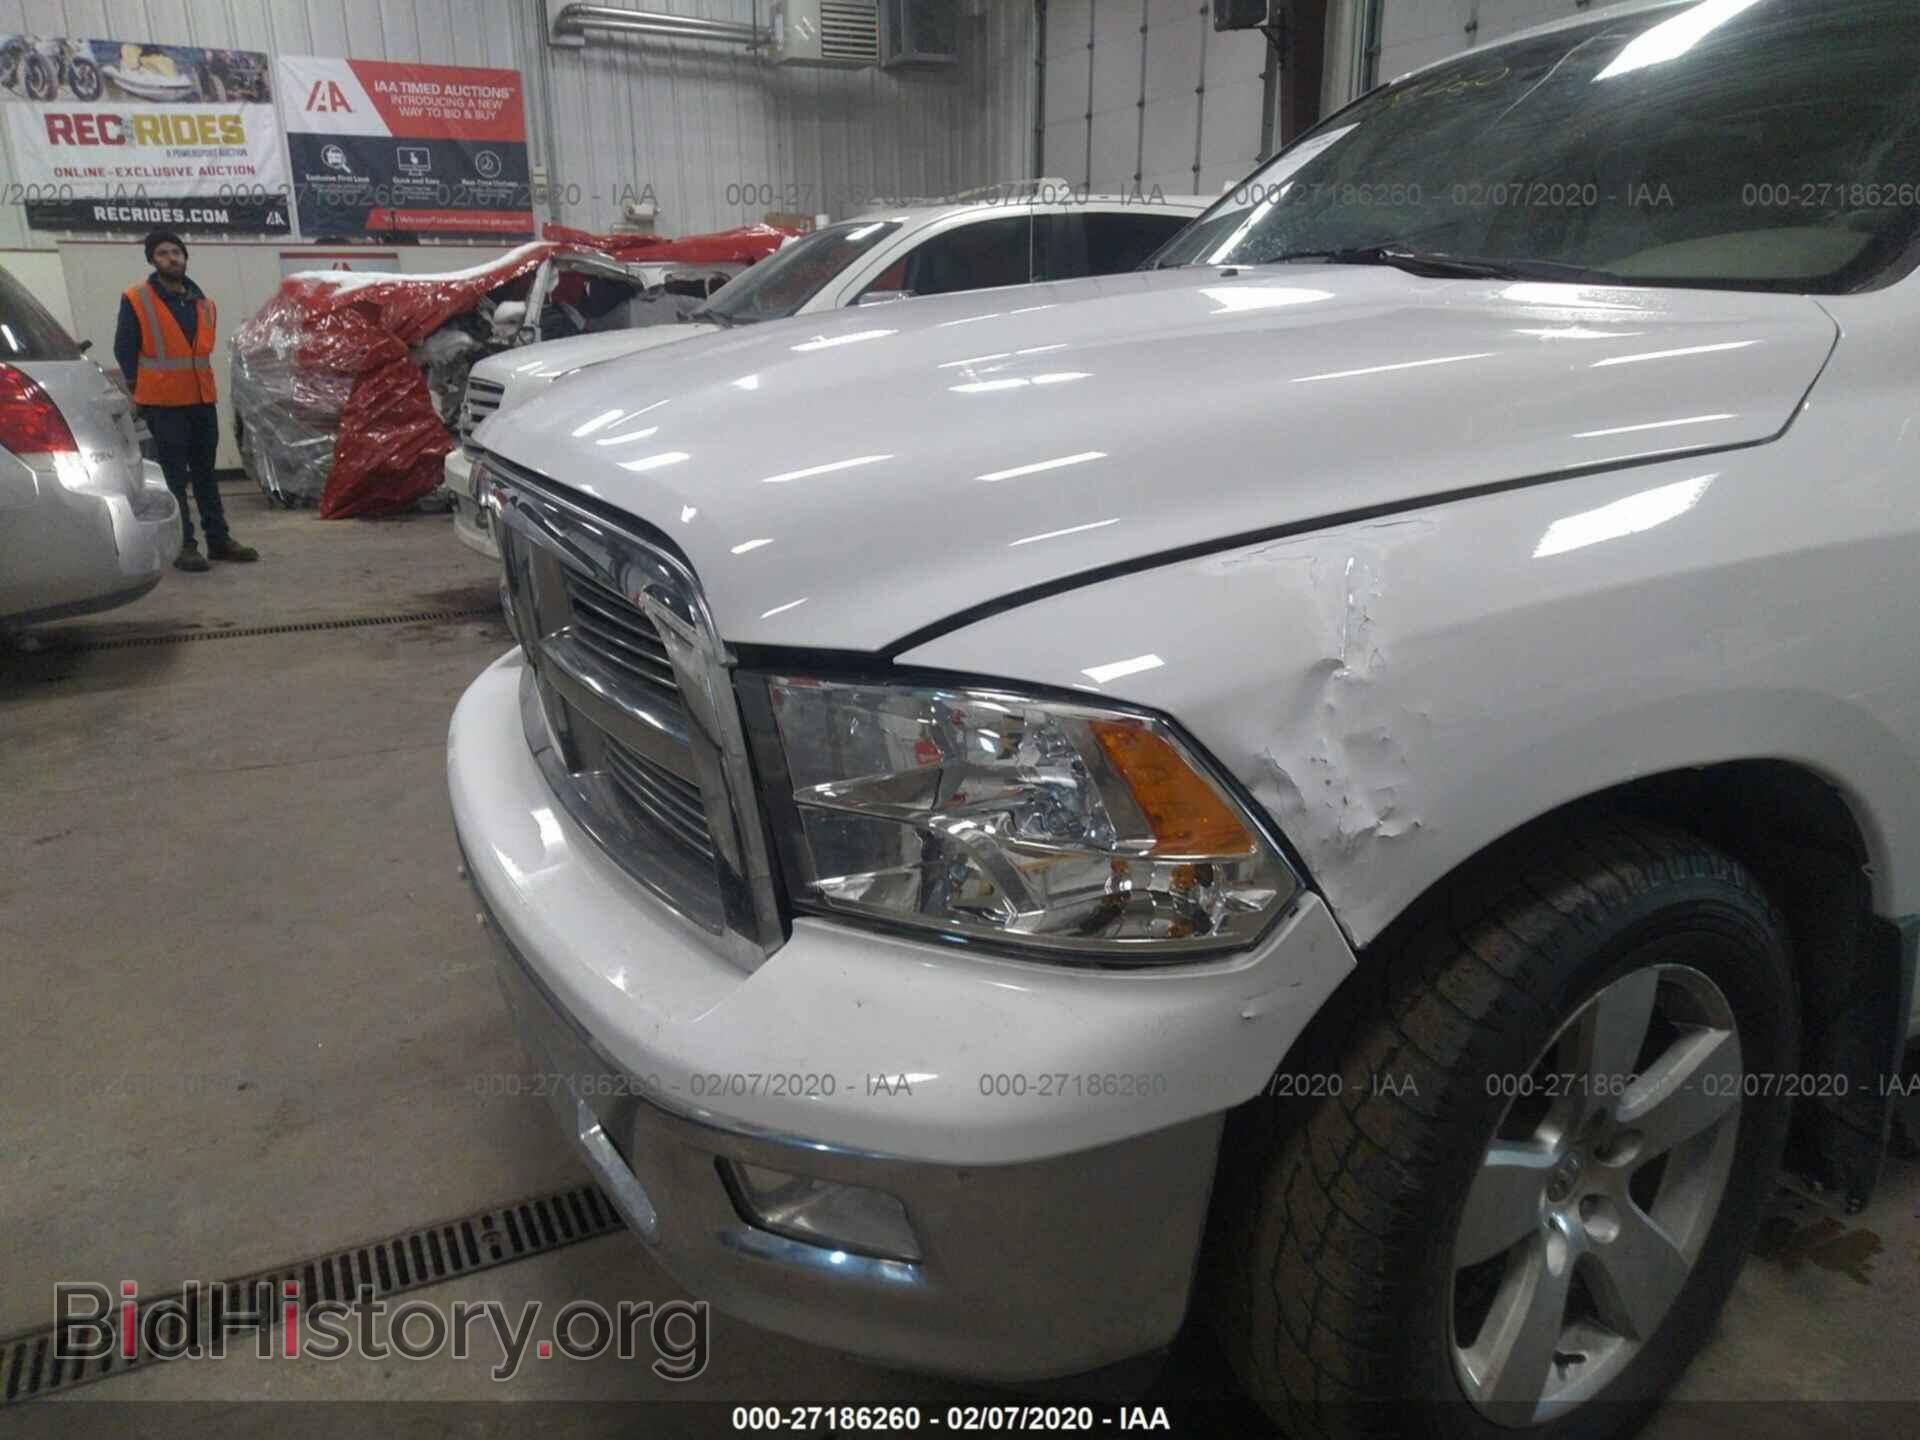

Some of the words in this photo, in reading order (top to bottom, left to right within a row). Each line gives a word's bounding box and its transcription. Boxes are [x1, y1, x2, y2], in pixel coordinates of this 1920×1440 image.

[374, 80, 398, 92] IAA
[400, 81, 440, 95] TIMED
[390, 95, 464, 108] INTRODUCING
[467, 99, 475, 108] A
[479, 100, 503, 110] NEW
[399, 106, 423, 117] WAY
[427, 107, 441, 118] TO
[444, 108, 461, 119] BID
[475, 110, 497, 120] BUY
[44, 113, 126, 146] REC
[132, 114, 246, 146] RIDES
[198, 165, 256, 176] AUCTION
[94, 206, 229, 223] RECRIDES.COM
